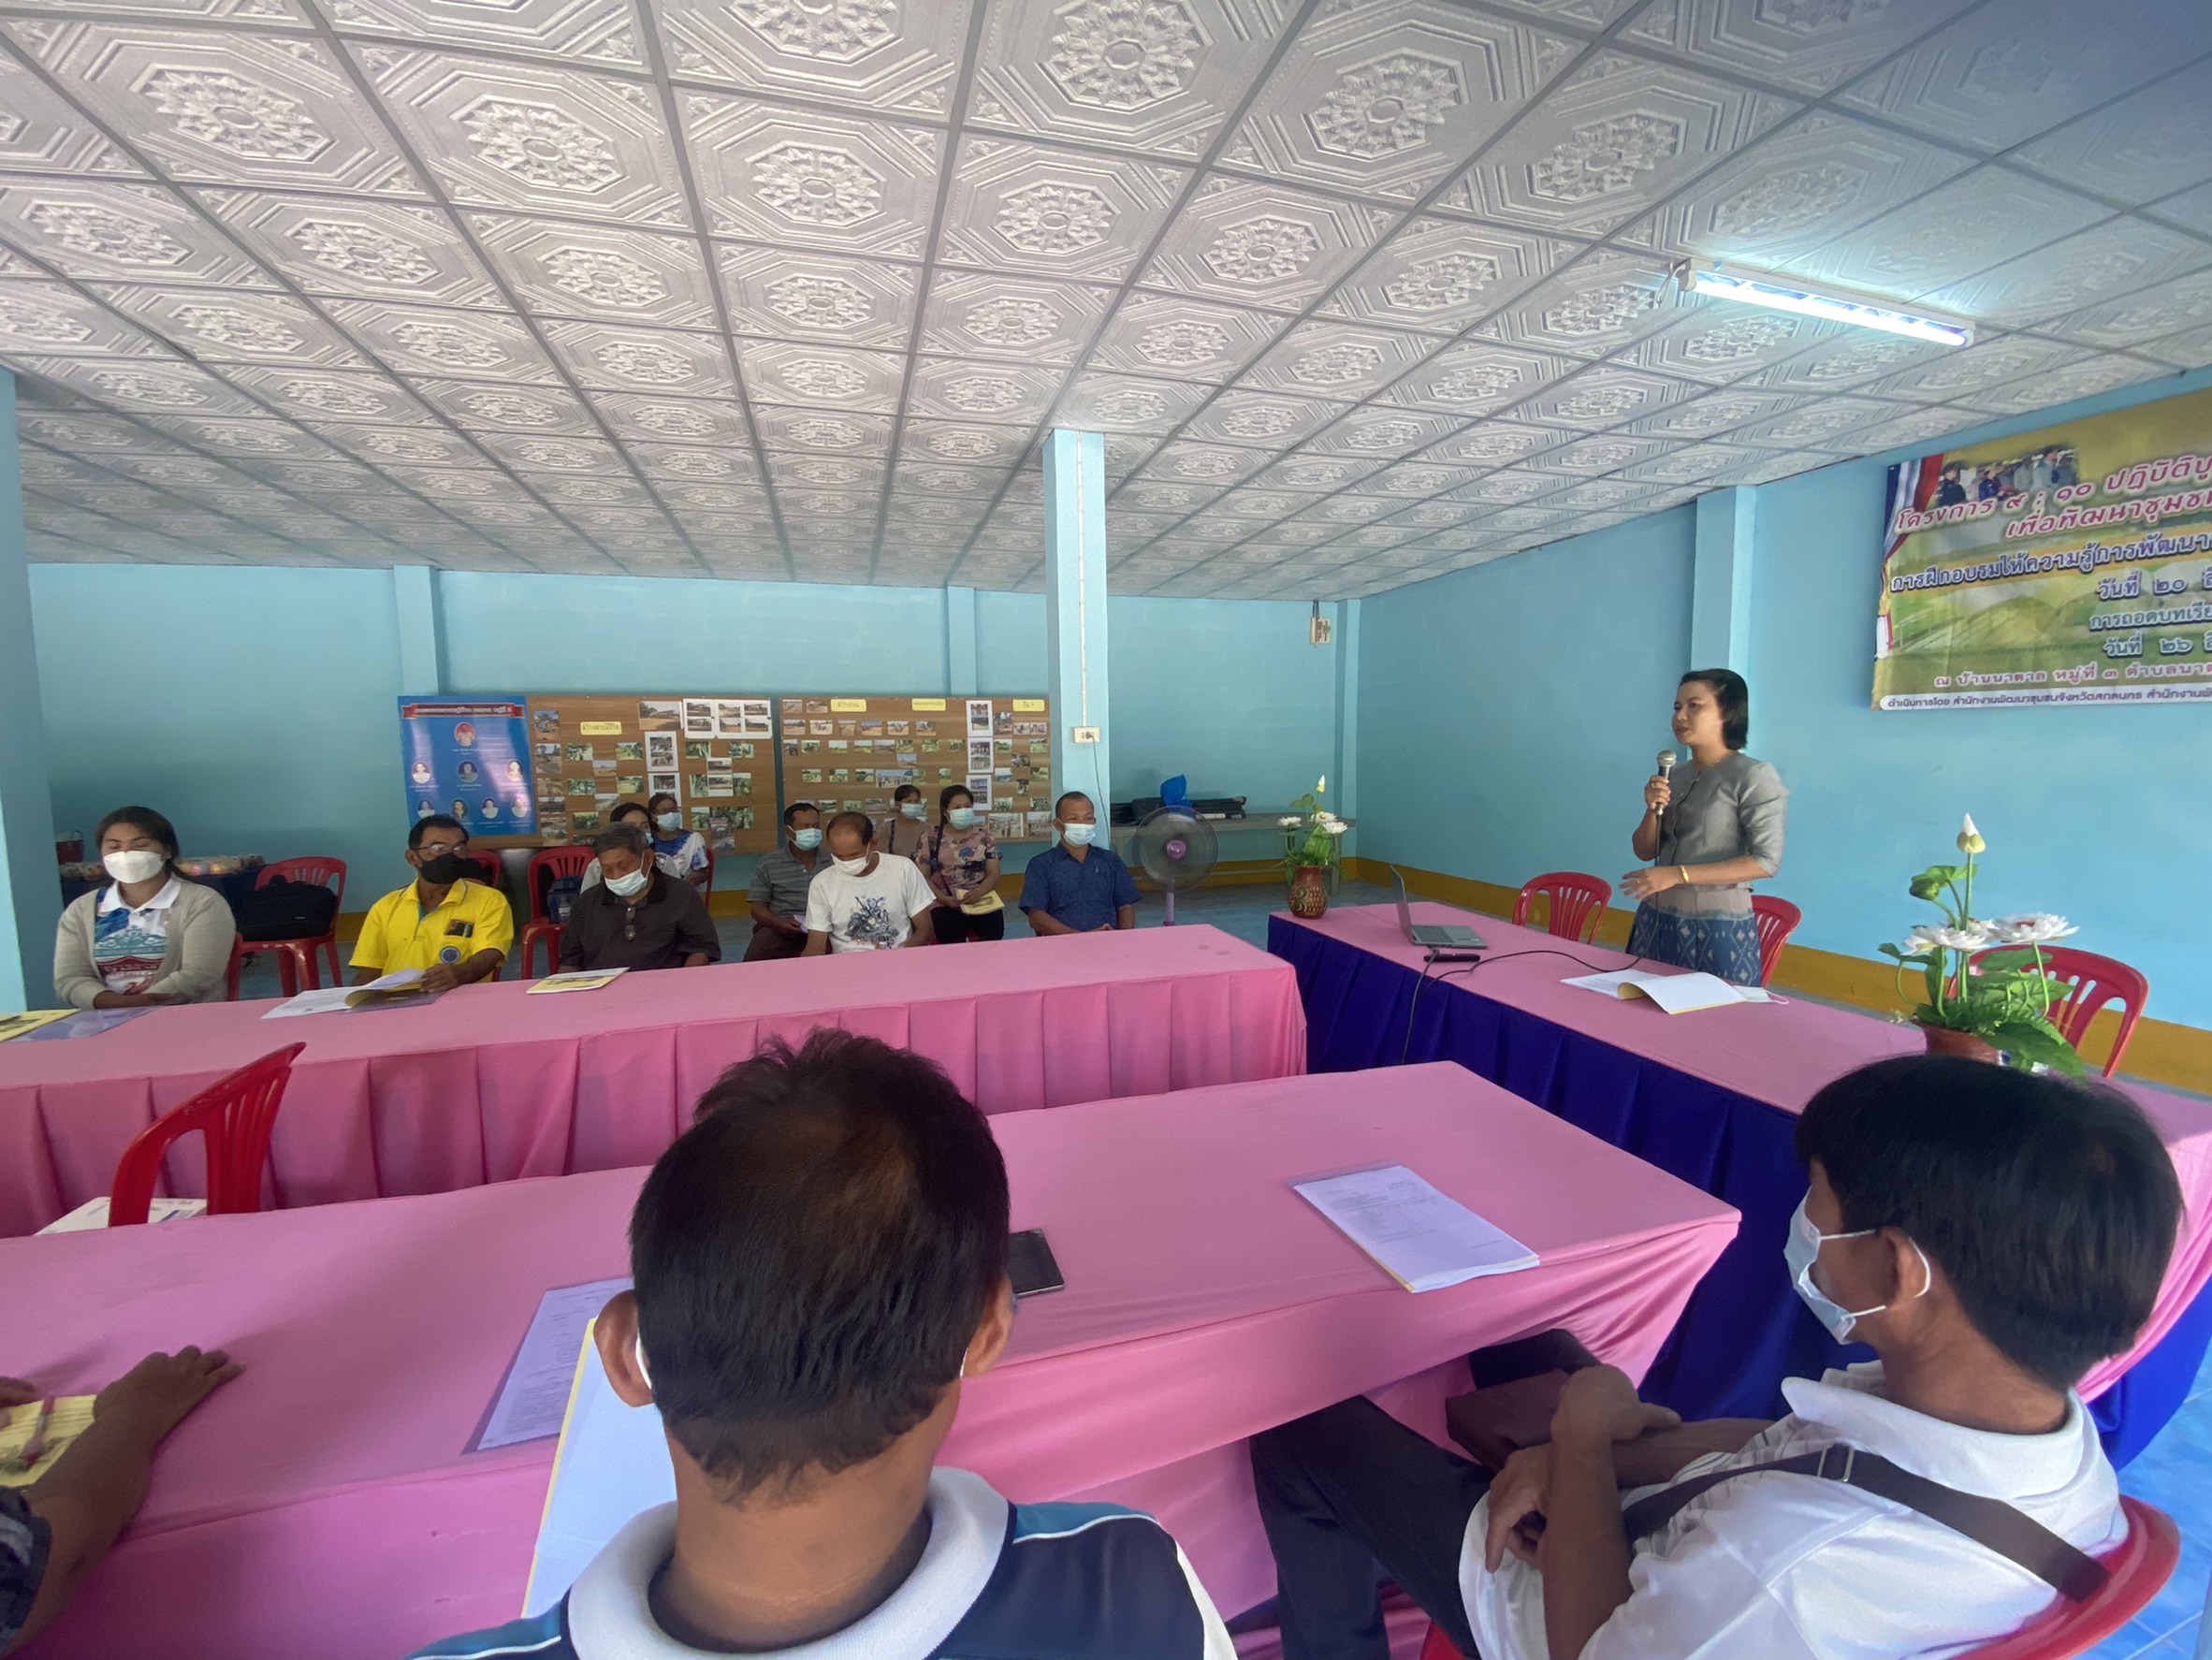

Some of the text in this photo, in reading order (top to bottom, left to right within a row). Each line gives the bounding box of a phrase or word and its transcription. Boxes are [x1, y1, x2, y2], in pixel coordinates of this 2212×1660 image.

[1897, 499, 1995, 531] โครงการ
[2056, 482, 2093, 502] ๑๐
[1891, 531, 2212, 591] การฝึกอบรมให้ความรู้การพัฒนา
[2097, 571, 2142, 600] วันที่
[2154, 577, 2188, 595] ๒๐
[2103, 633, 2143, 657] วันที่
[2160, 638, 2193, 654] ๒๖
[1935, 677, 1951, 686] ณ
[2055, 662, 2097, 683] หมู่ที่
[2103, 669, 2119, 678] ๓
[1887, 695, 1951, 707] ดำเนินการโดย
